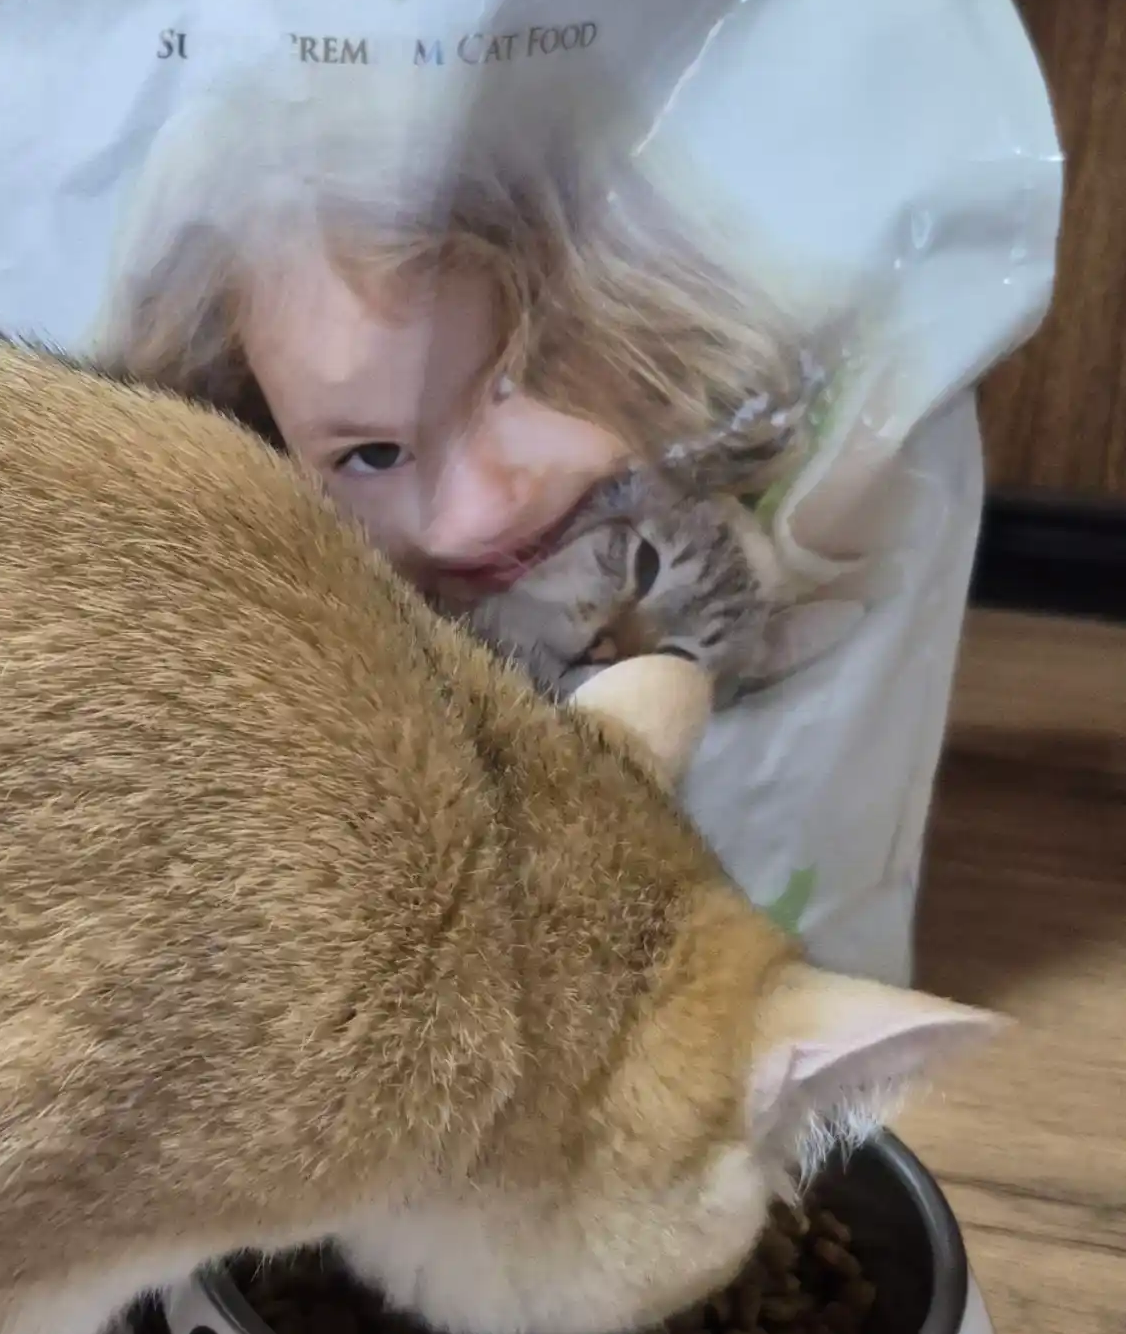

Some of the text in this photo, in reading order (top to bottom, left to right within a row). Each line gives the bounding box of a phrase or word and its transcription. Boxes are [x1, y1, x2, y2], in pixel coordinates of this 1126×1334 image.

[288, 22, 597, 66] REMM CAT FOOD
